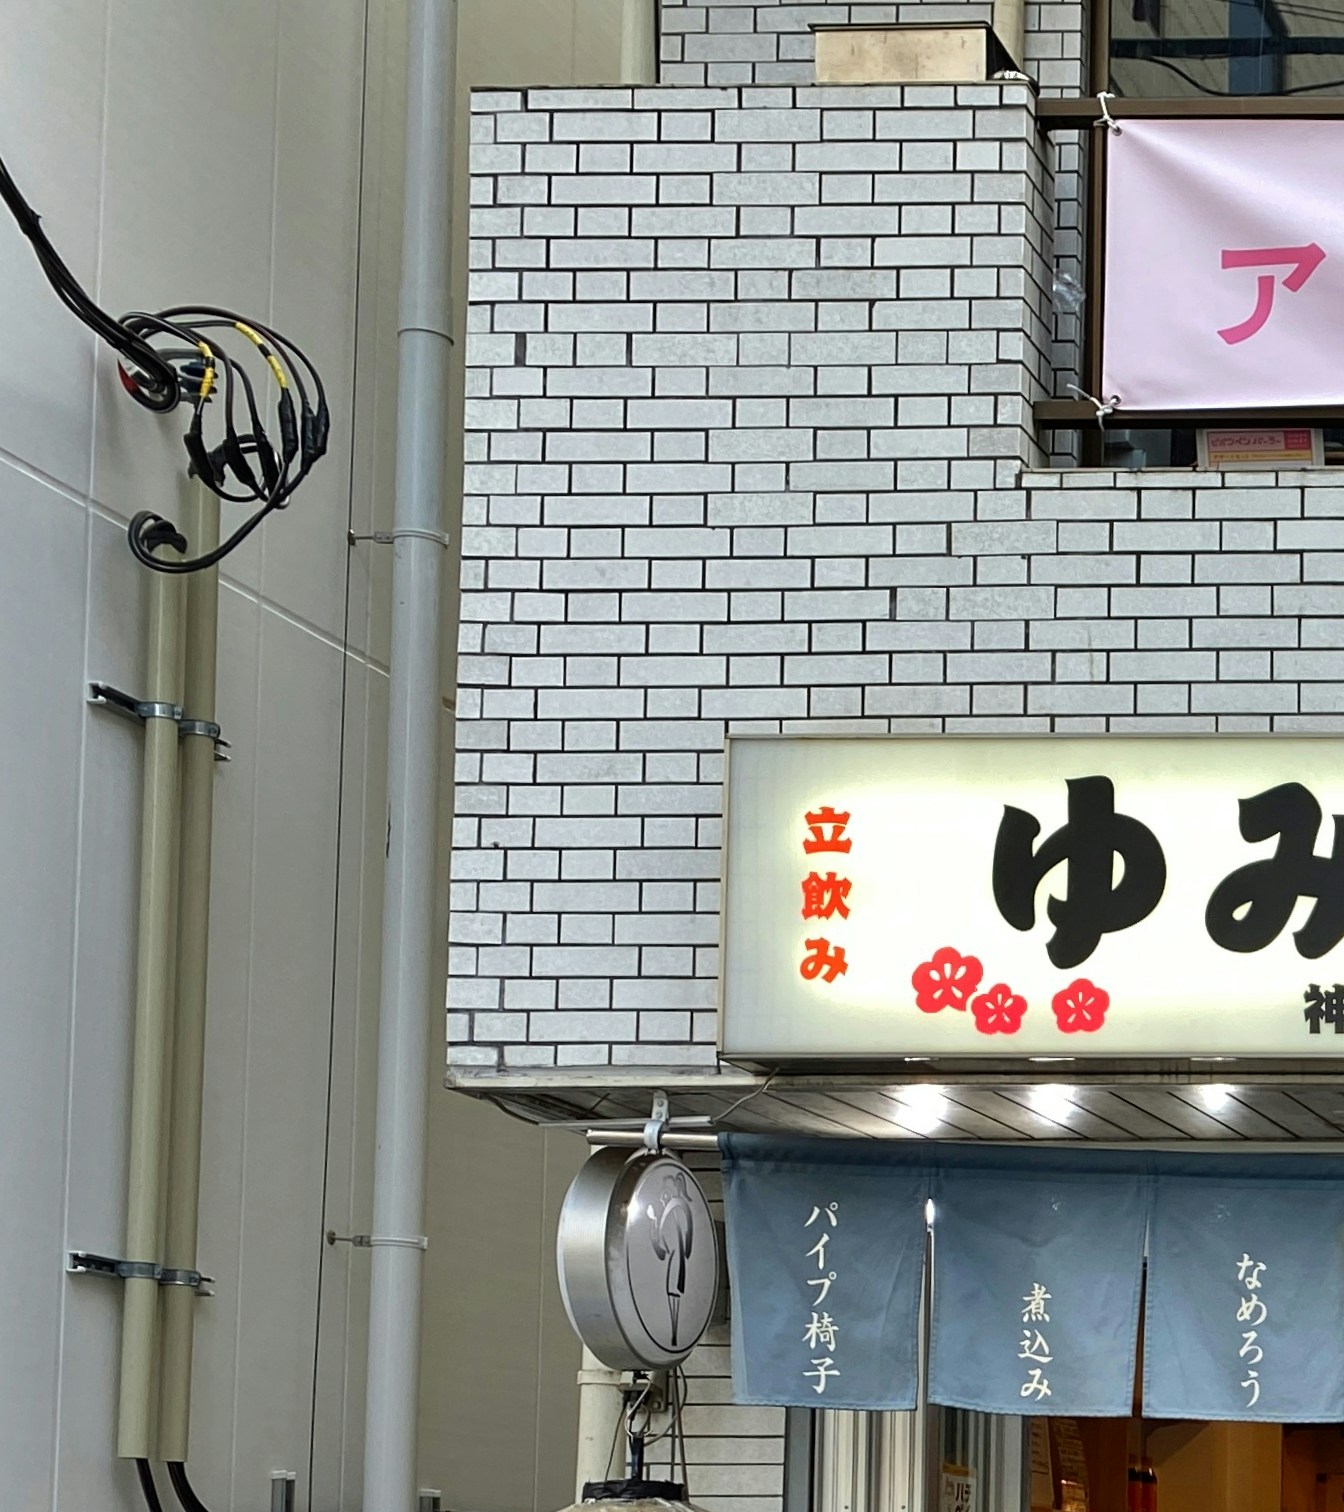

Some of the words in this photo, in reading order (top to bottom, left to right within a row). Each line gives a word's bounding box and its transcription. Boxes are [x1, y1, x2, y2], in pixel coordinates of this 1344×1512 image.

[800, 805, 853, 984] 立飲み
[801, 1201, 841, 1395] パイプ椅子
[1017, 1282, 1054, 1402] 煮込み
[1235, 1253, 1268, 1410] なめろう
